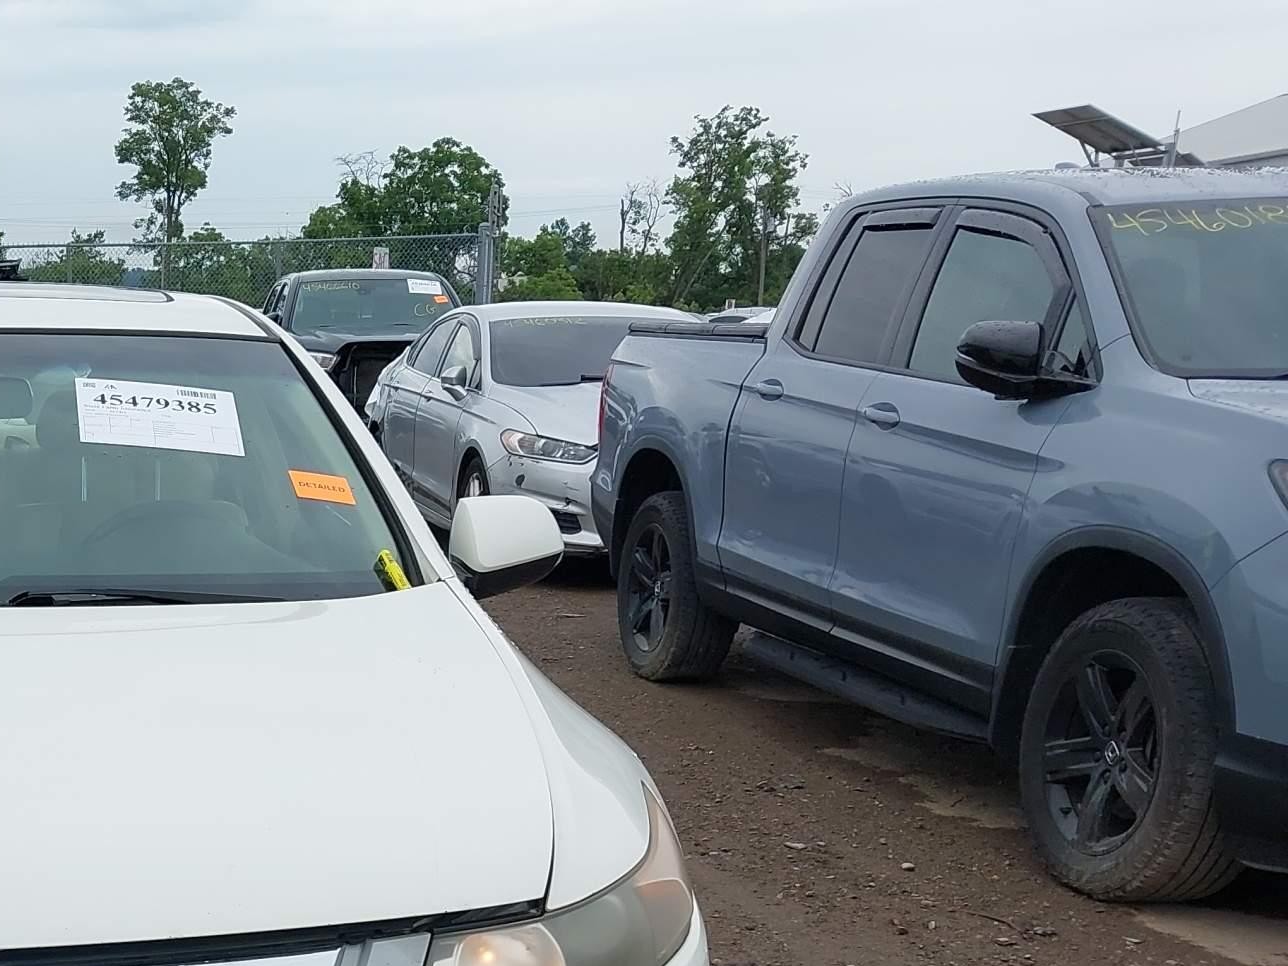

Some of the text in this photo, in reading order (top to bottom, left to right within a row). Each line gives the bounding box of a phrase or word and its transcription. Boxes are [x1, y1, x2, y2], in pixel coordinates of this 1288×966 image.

[1107, 205, 1288, 236] 4546018
[93, 393, 217, 415] 45479385
[298, 481, 346, 493] DETAILED
